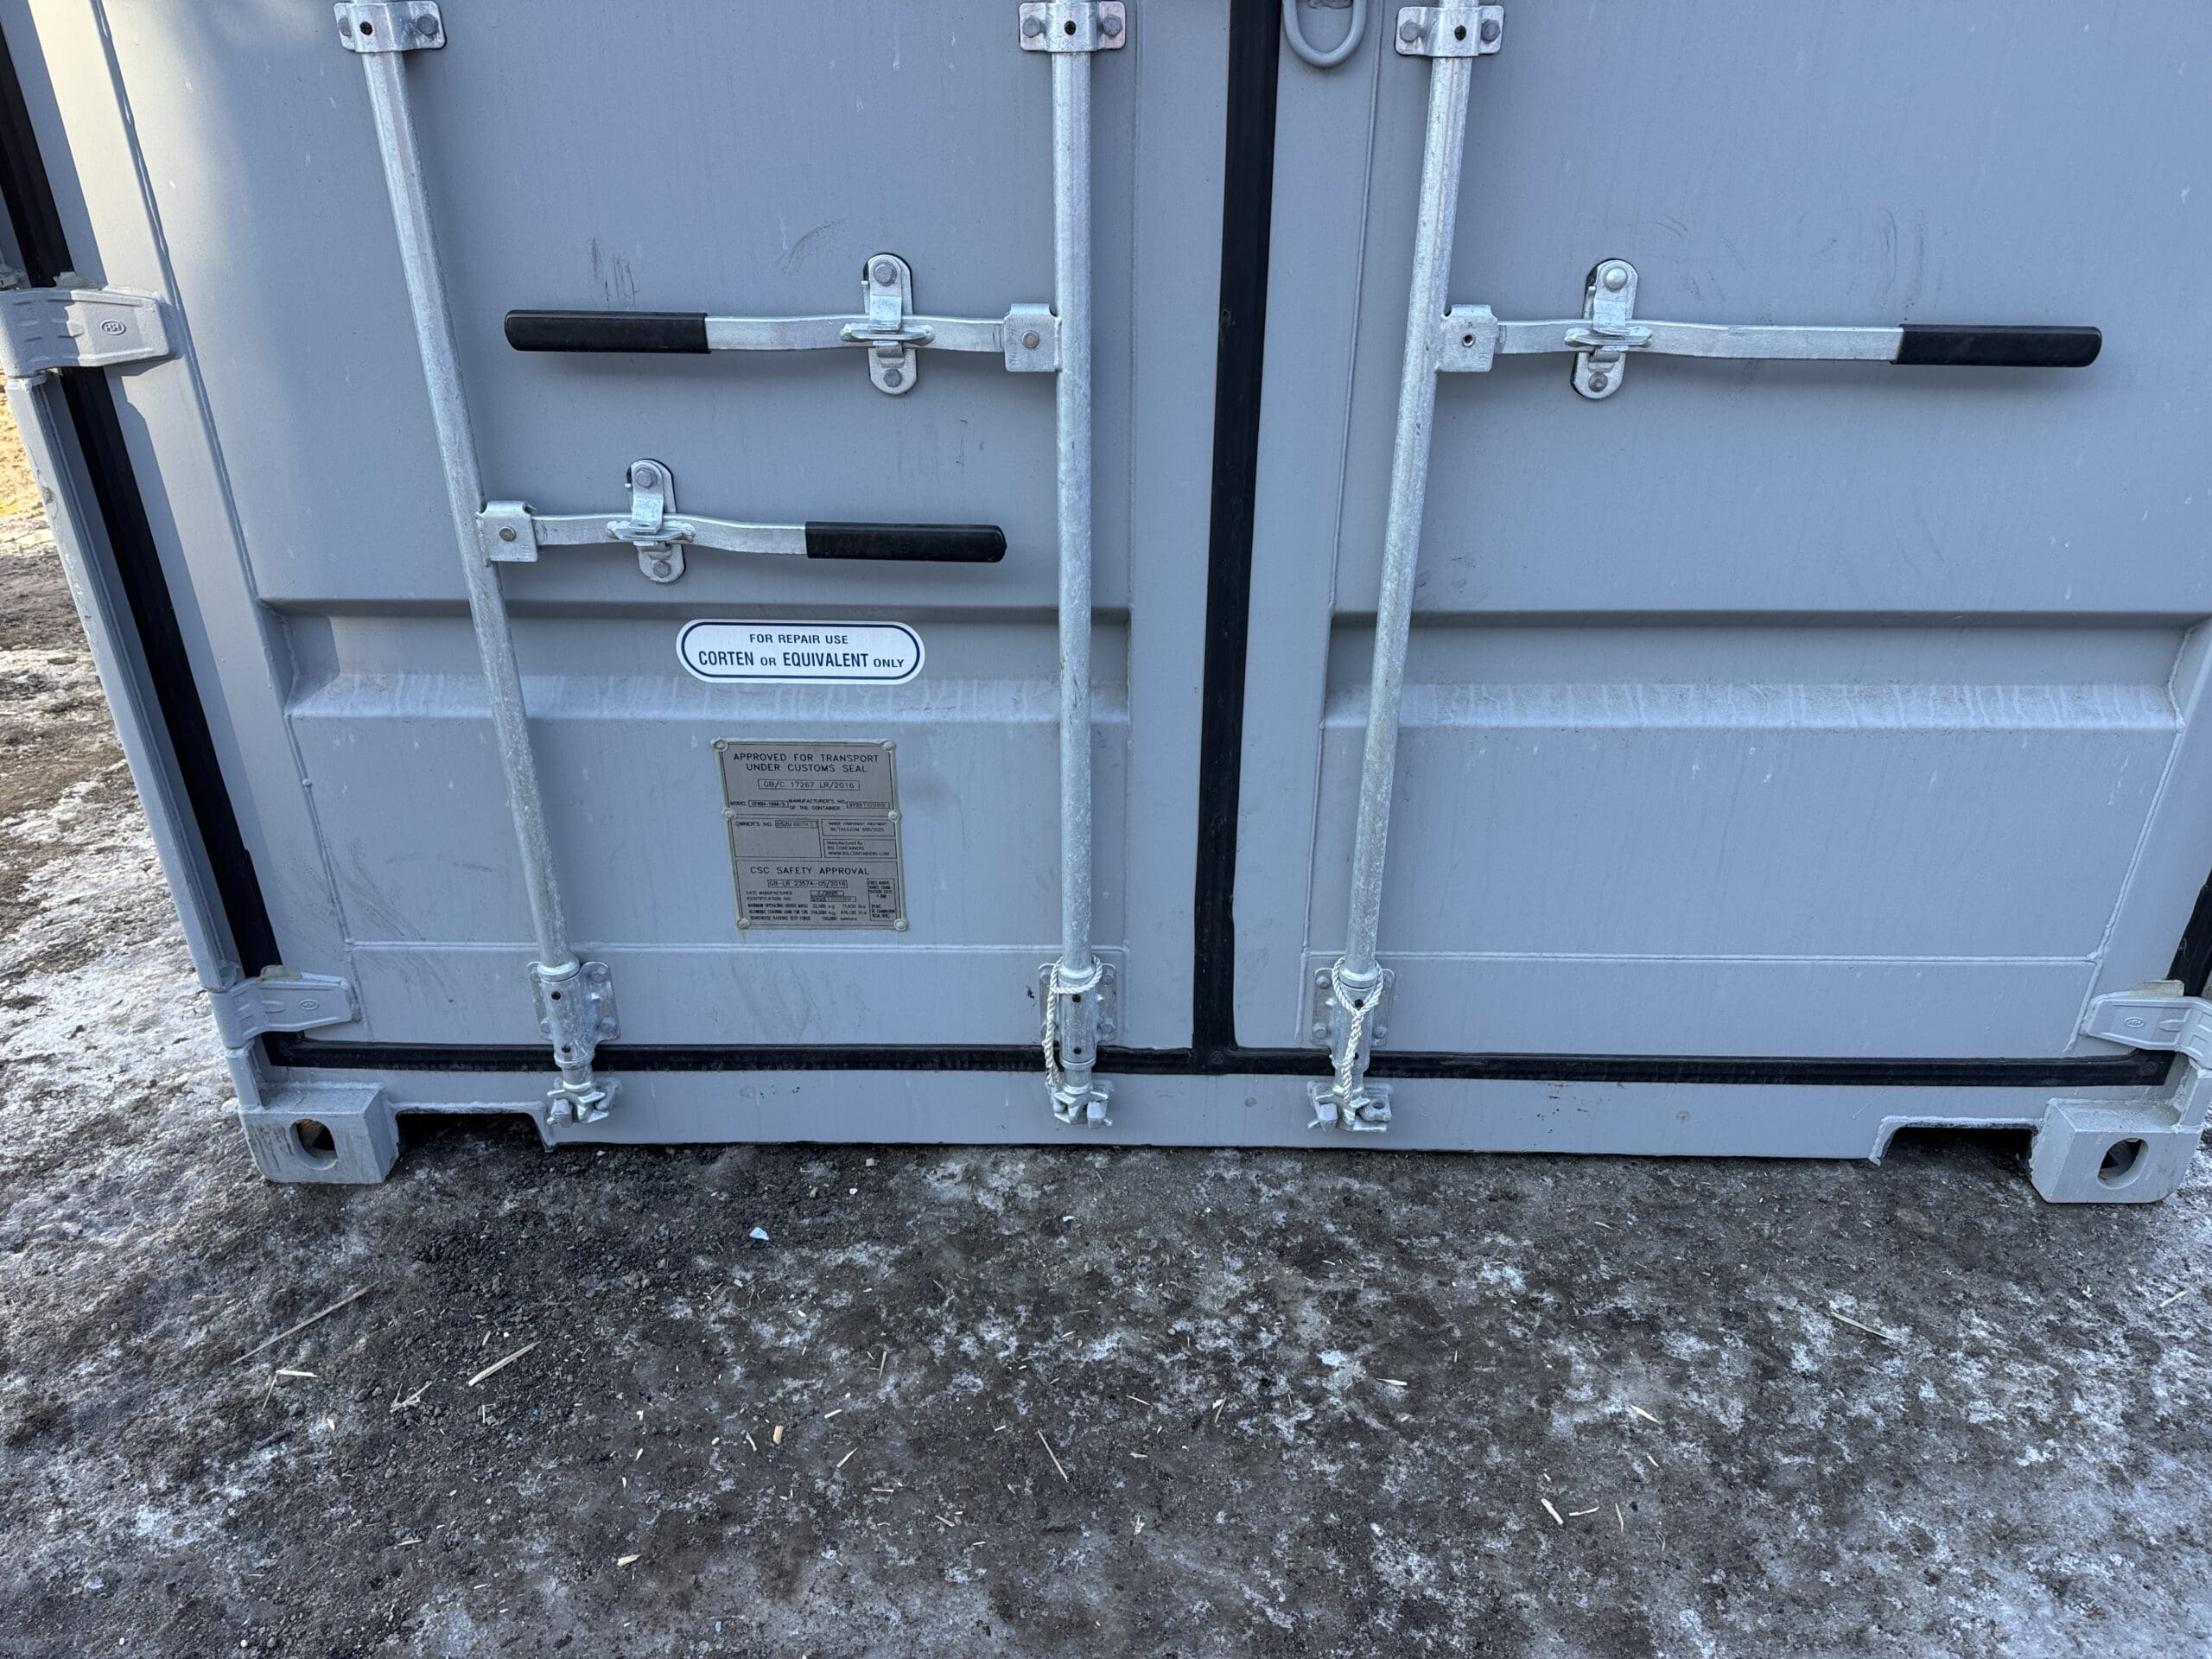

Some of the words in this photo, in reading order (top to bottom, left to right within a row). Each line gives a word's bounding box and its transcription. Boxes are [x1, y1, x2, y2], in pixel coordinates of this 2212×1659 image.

[749, 633, 772, 644] FOR
[778, 634, 820, 645] REPAIR
[825, 635, 849, 645] USE
[698, 651, 754, 666] CORTEN
[760, 657, 776, 666] OR
[783, 652, 868, 667] EQUIVALENT
[873, 658, 905, 668] ONLY
[733, 753, 787, 762] APPROVED
[794, 753, 813, 762] FOR
[820, 753, 879, 763] TRANSPORT
[787, 764, 836, 772] CUSTOMS
